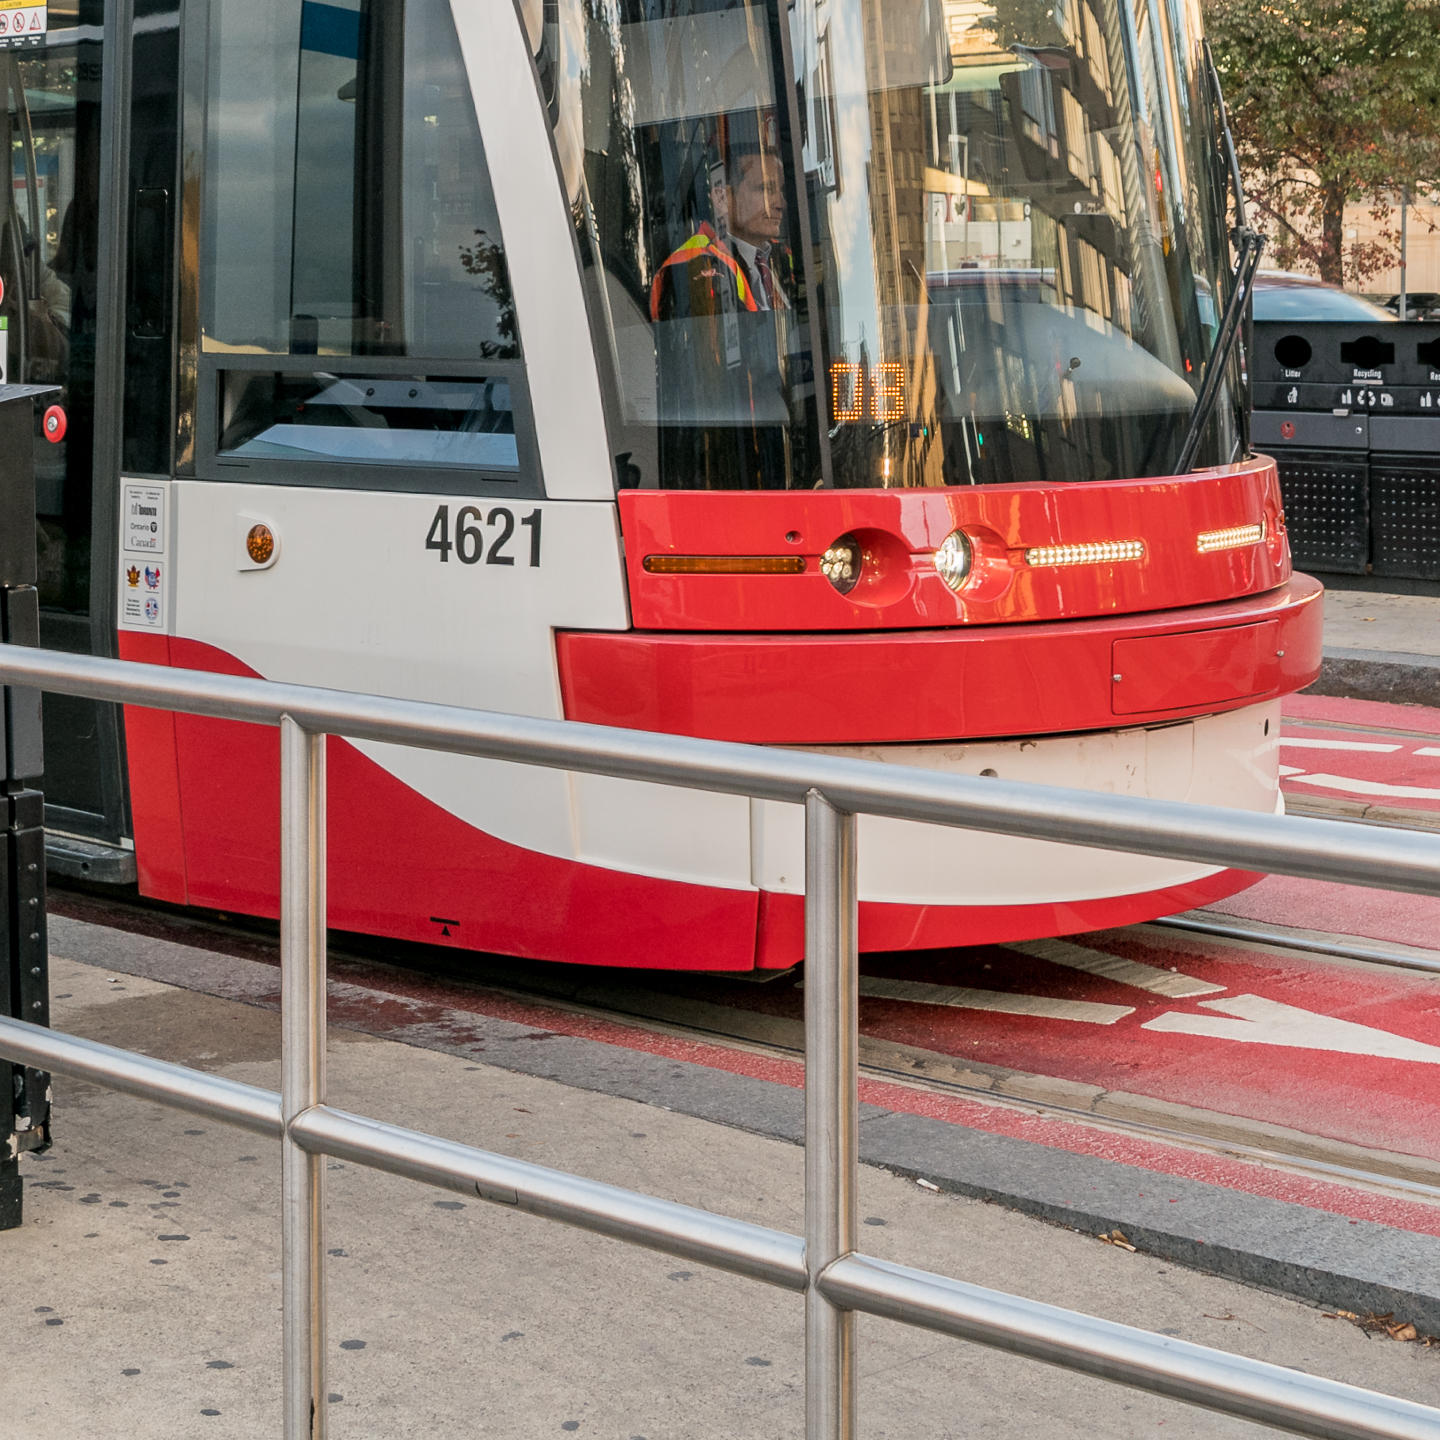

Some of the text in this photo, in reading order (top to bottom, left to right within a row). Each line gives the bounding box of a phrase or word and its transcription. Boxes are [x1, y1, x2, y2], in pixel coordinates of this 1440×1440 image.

[1285, 369, 1301, 378] Litter
[1353, 369, 1382, 379] Recycling
[130, 522, 150, 531] Ontario
[425, 505, 542, 568] 4621
[131, 536, 156, 548] Canada
